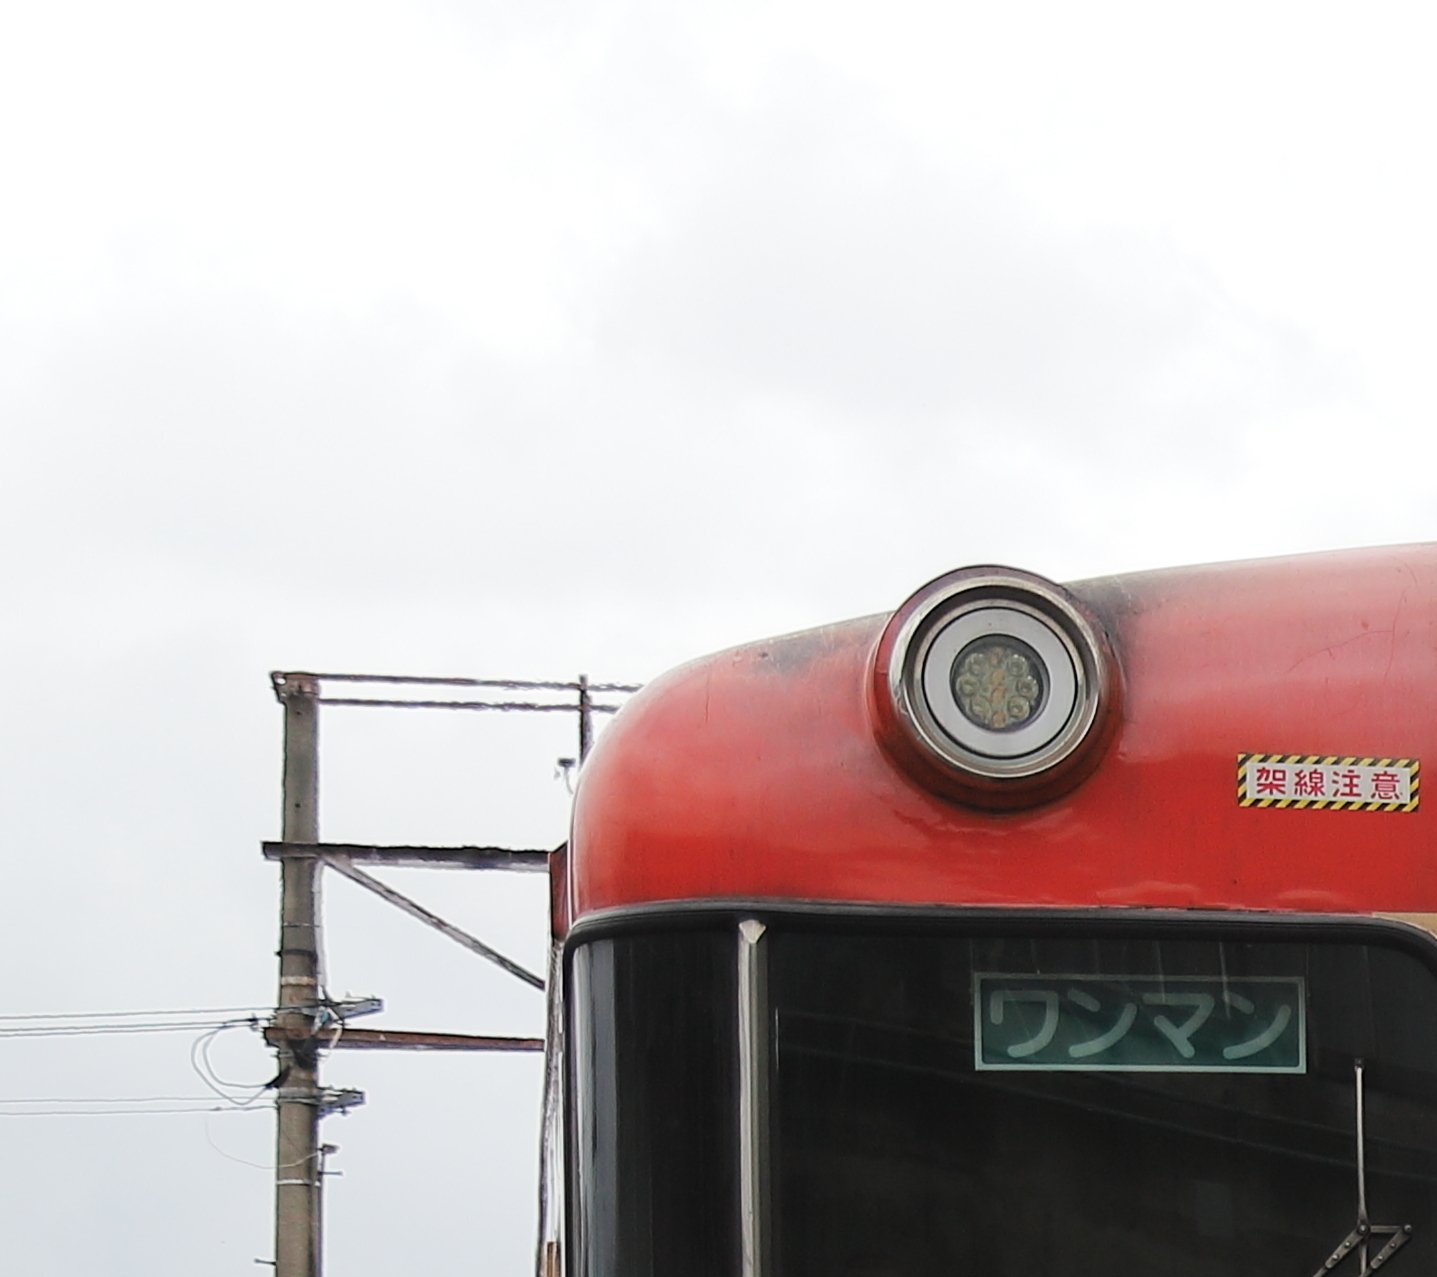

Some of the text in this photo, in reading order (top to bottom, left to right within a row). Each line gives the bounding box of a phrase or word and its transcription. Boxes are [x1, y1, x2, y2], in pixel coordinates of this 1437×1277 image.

[1256, 766, 1401, 801] 架線注意
[989, 987, 1292, 1060] ワンマン
